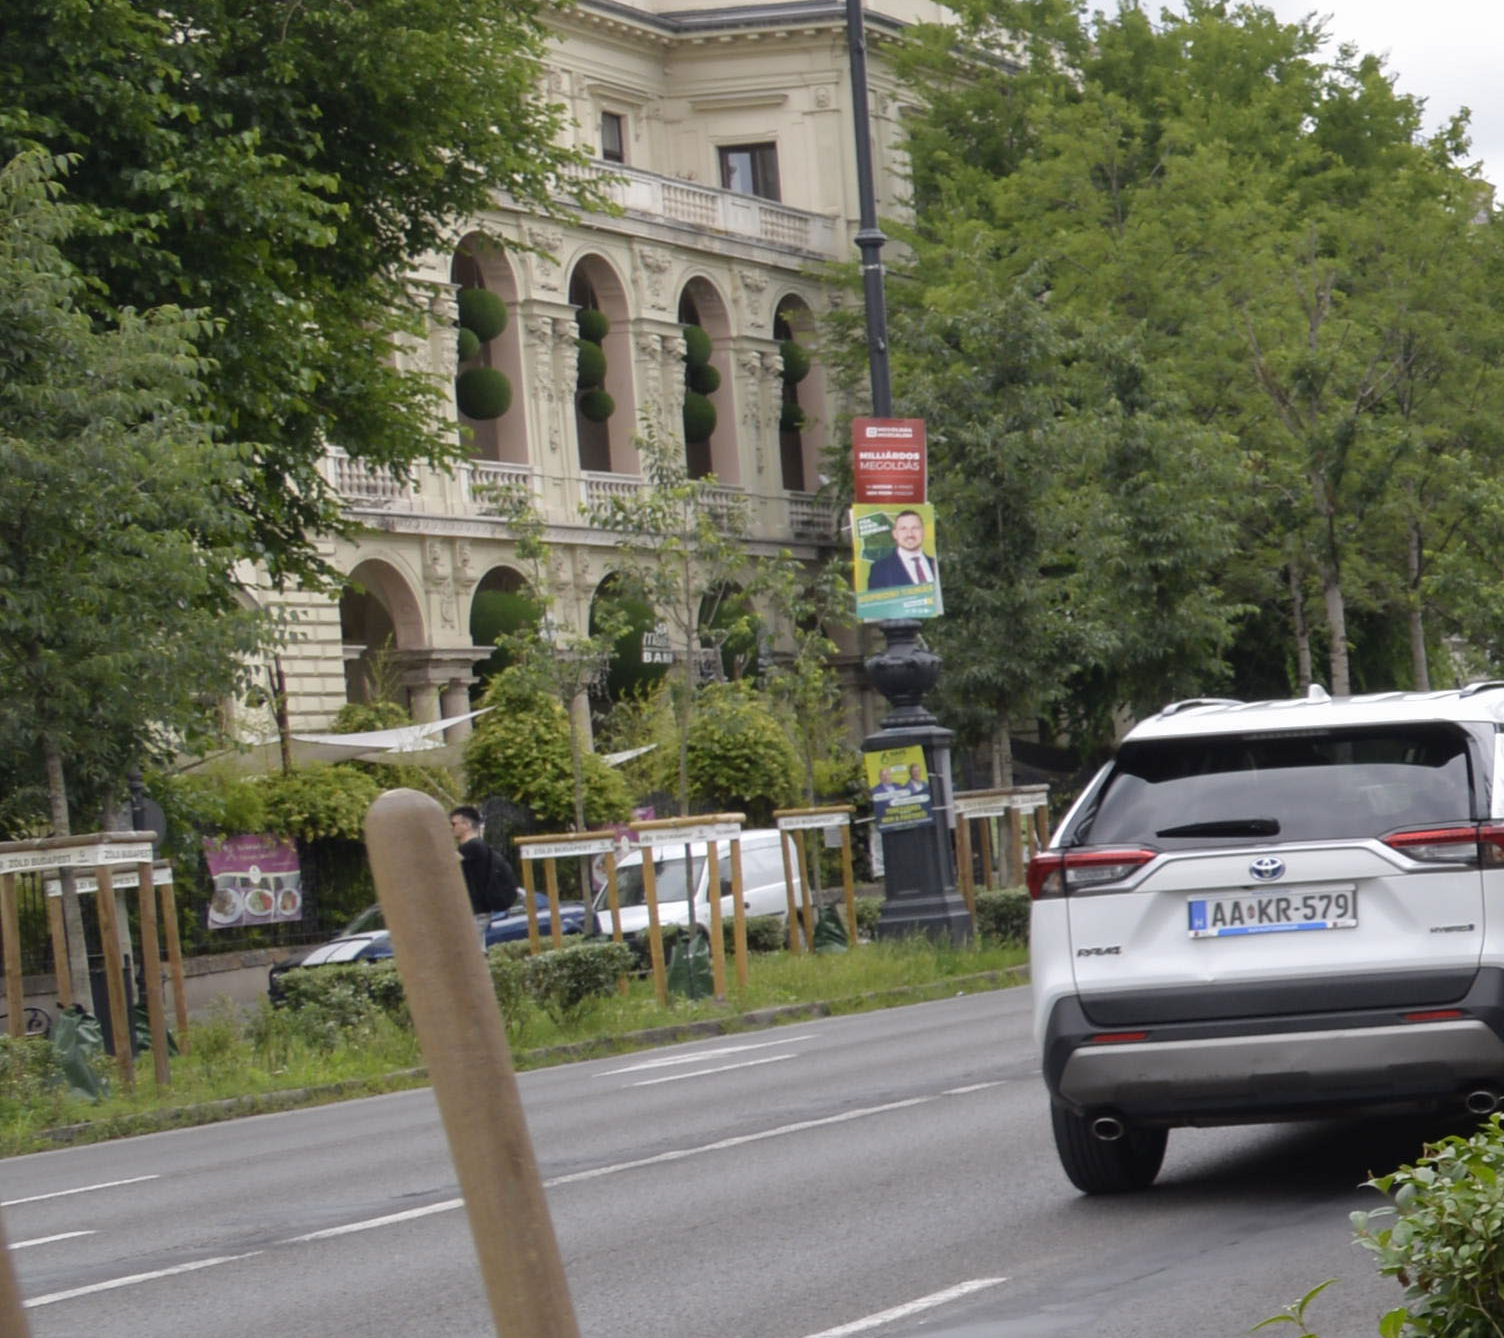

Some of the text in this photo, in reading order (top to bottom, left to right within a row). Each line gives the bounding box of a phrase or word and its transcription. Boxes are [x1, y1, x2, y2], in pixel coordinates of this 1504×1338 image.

[859, 450, 920, 460] MILLIÁRDOS
[860, 460, 920, 472] MEGOLDÁS
[1212, 901, 1245, 928] AA
[1258, 893, 1349, 924] KR-579
[1077, 946, 1121, 958] RAV4
